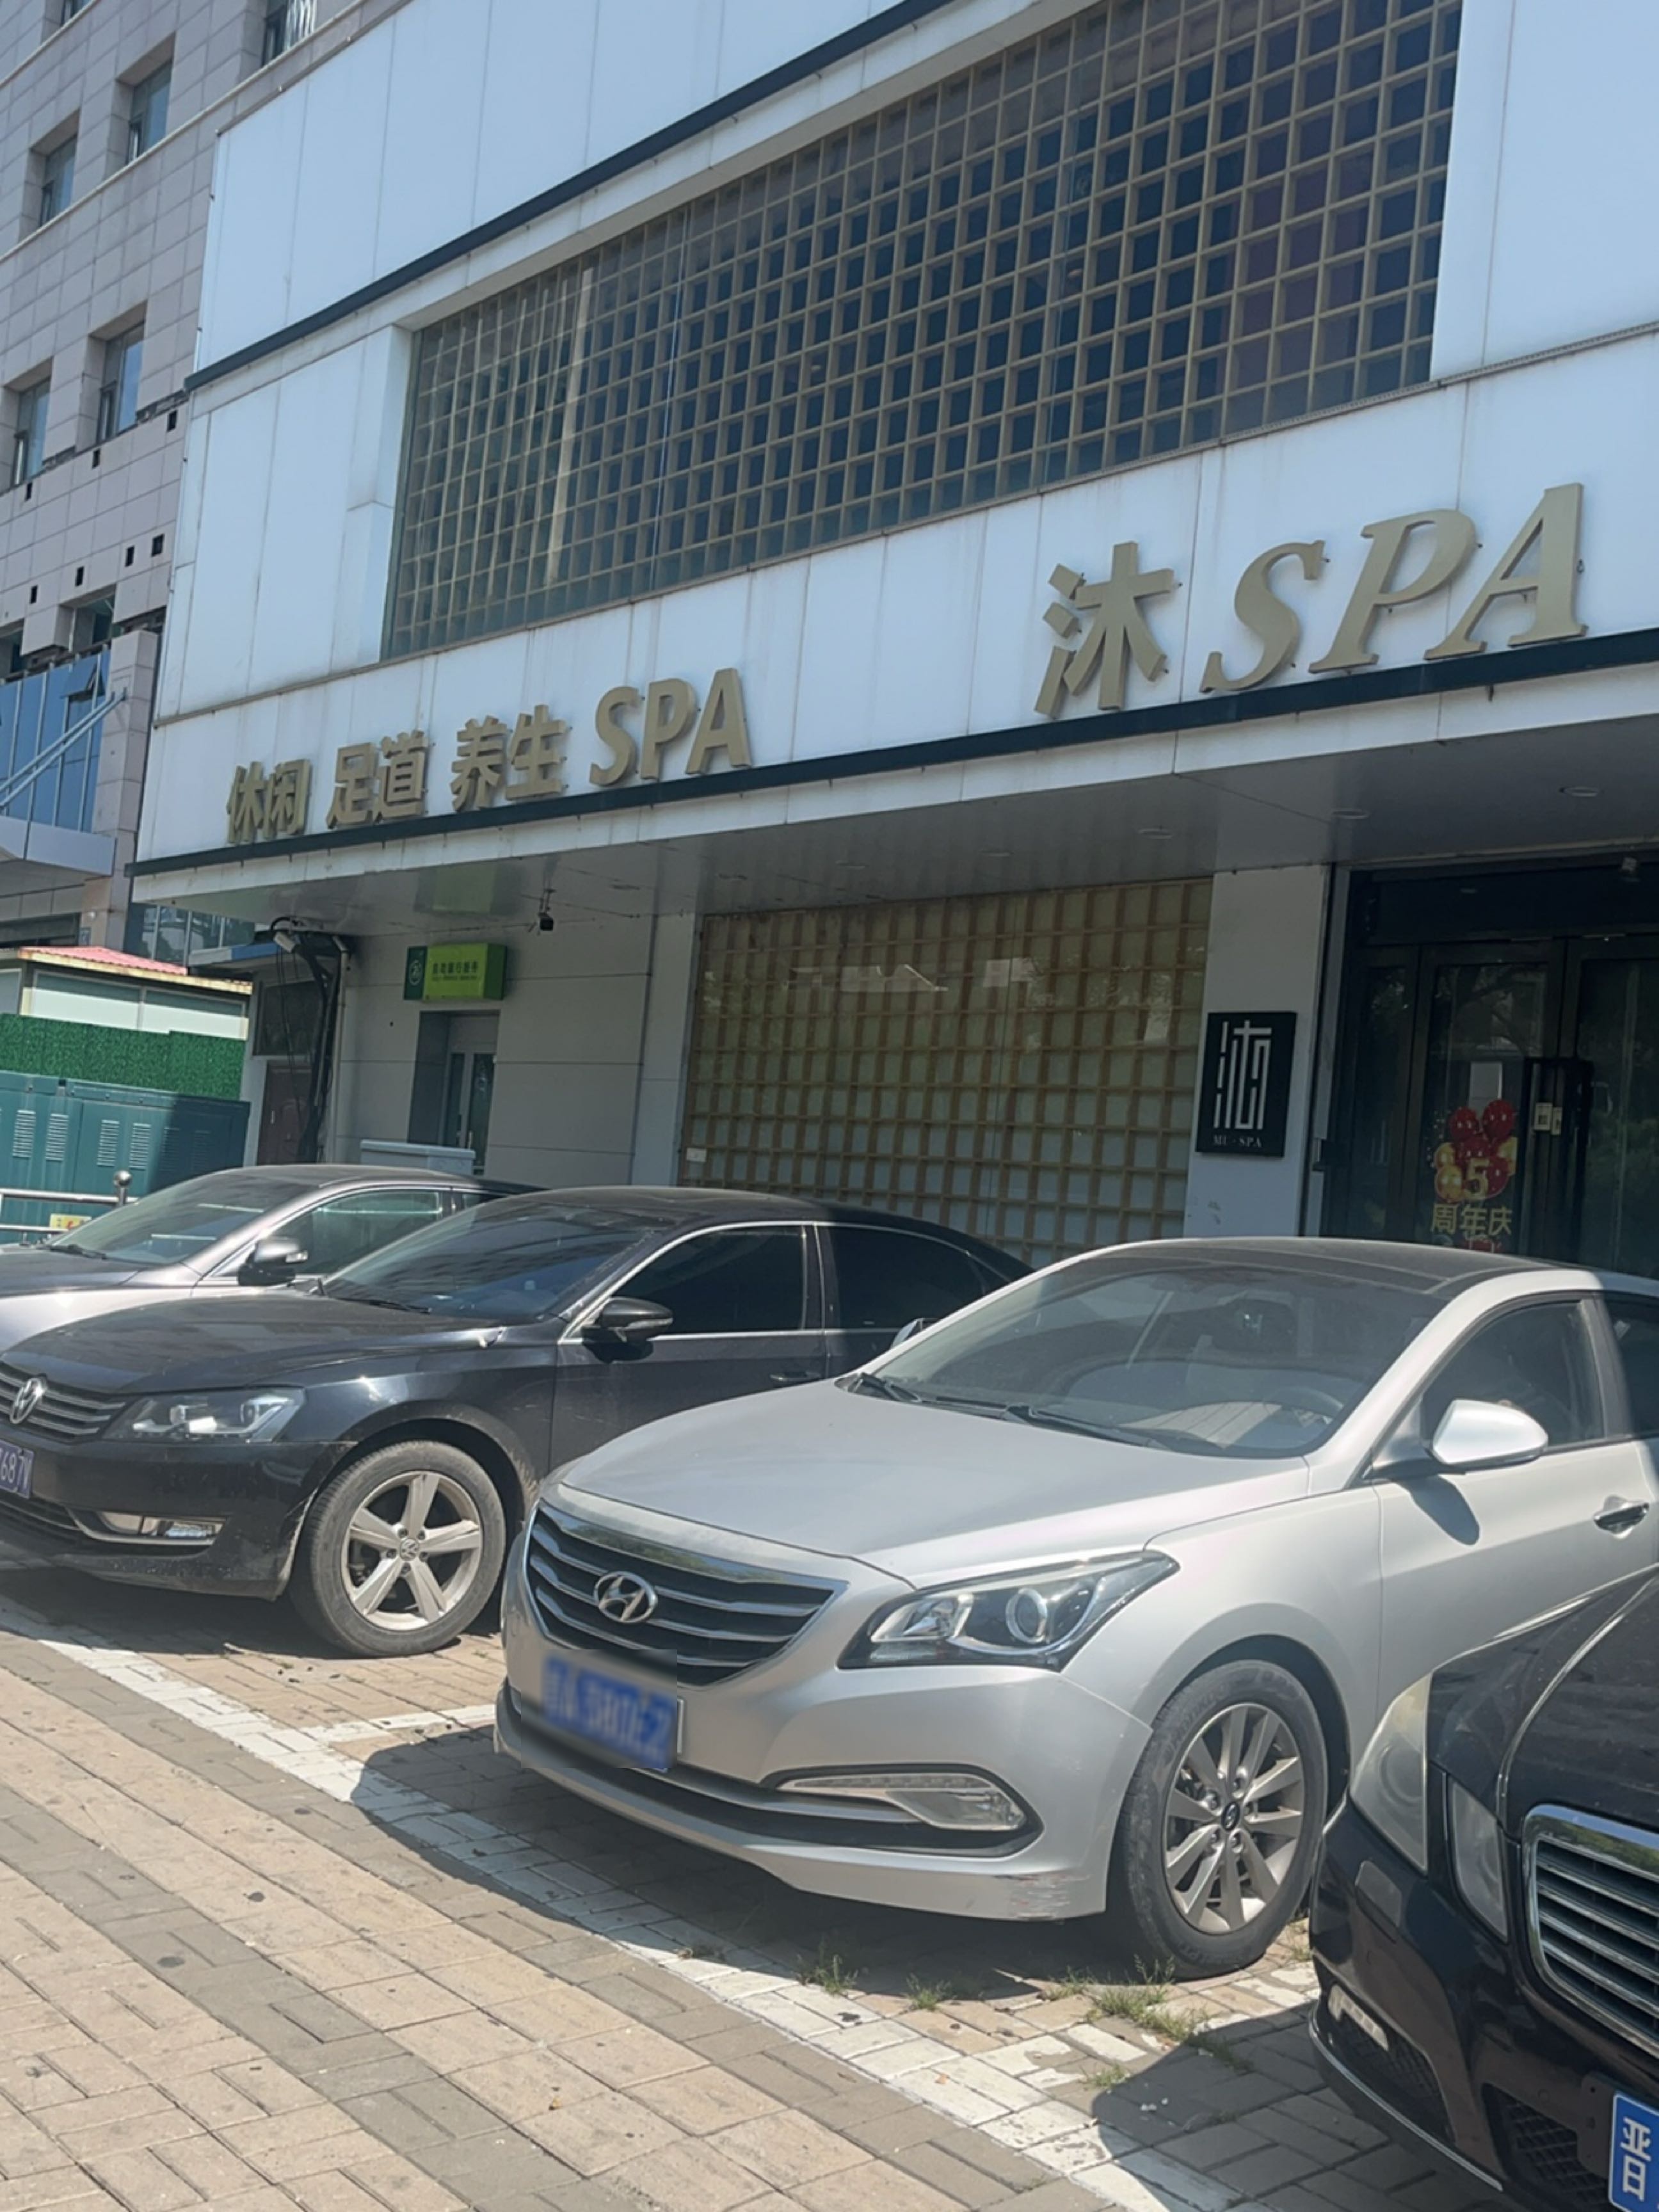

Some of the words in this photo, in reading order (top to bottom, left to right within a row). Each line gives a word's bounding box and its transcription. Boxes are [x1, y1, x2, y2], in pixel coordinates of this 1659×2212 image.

[1034, 540, 1176, 719] 沐
[1198, 482, 1589, 694] SPA
[226, 758, 312, 845] 休闲
[326, 729, 430, 830] 足道
[450, 704, 568, 813] 养生
[589, 667, 753, 787] SPA
[1430, 1203, 1513, 1237] 周年庆
[1463, 1157, 1490, 1201] 5
[1620, 2116, 1652, 2202] 晋
